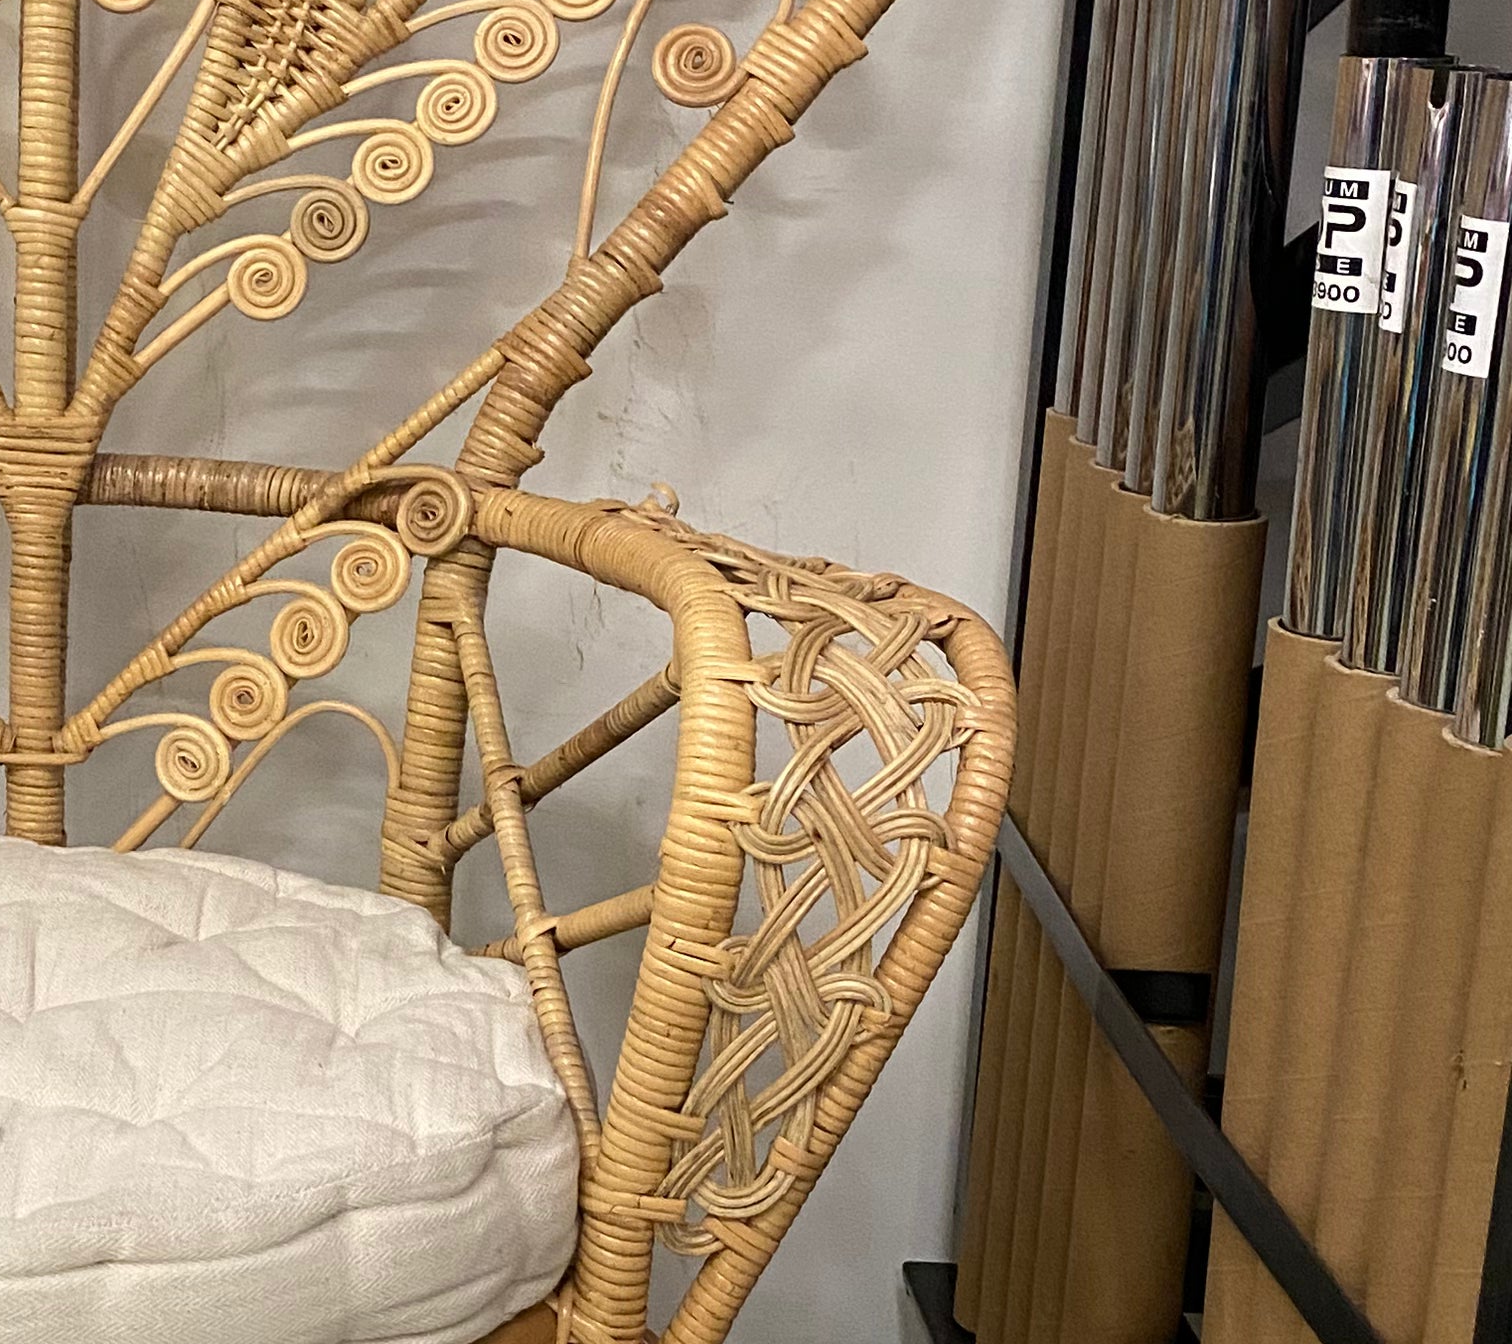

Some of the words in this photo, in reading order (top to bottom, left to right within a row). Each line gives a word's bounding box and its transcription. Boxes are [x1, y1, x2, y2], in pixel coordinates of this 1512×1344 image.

[1324, 203, 1367, 249] P
[1463, 231, 1479, 250] M
[1454, 314, 1467, 332] E
